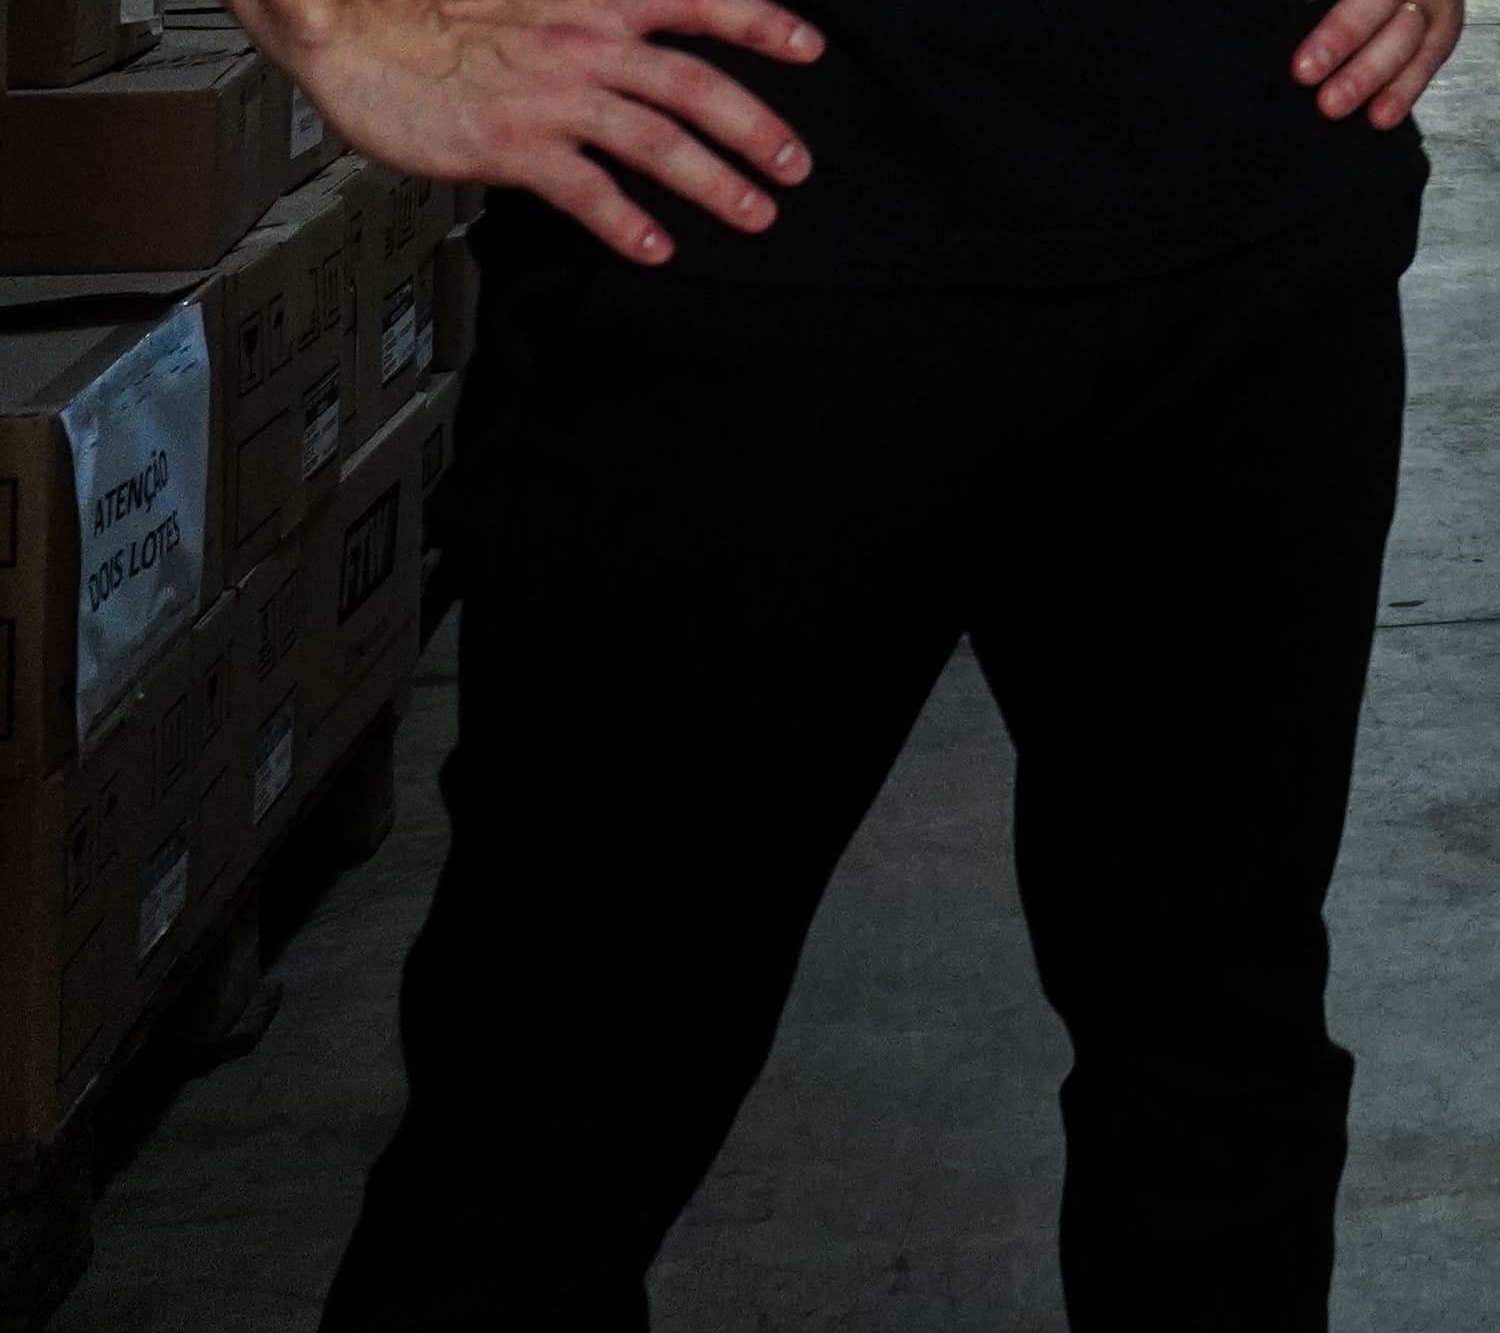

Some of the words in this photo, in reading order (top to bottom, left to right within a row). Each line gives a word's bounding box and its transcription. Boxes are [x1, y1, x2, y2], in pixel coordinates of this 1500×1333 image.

[94, 449, 169, 536] ATENÇÃO
[88, 556, 124, 613] DOIS
[128, 512, 181, 581] LOTES
